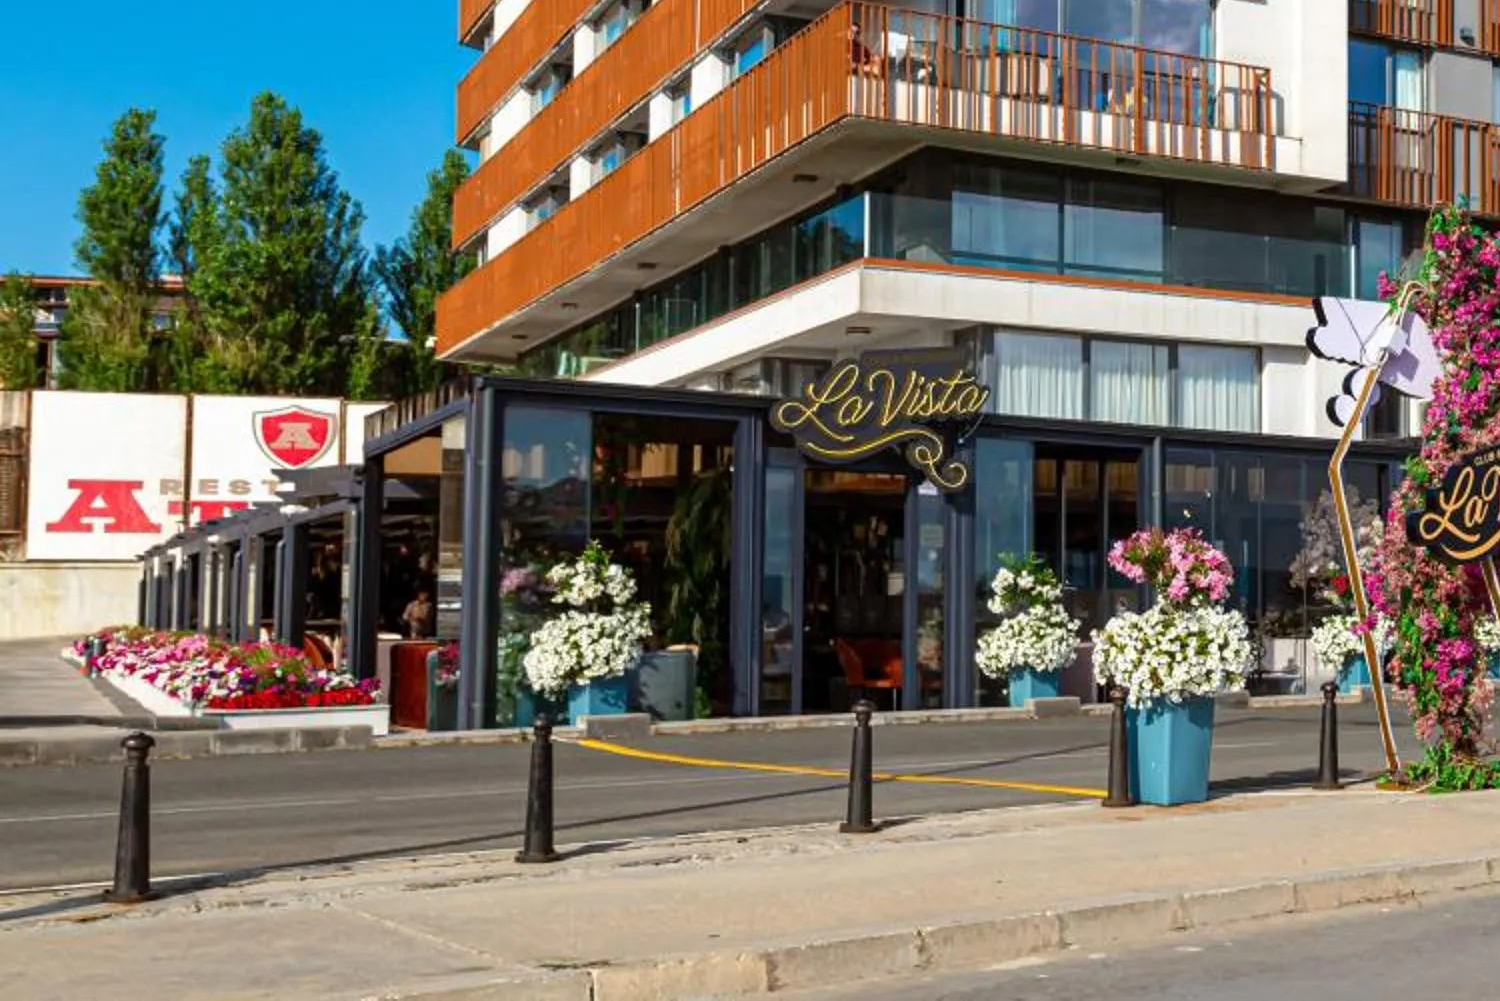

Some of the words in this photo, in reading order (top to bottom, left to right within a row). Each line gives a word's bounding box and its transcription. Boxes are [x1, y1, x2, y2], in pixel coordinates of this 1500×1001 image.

[777, 364, 873, 442] La
[869, 369, 989, 426] Vista
[1419, 466, 1489, 543] La
